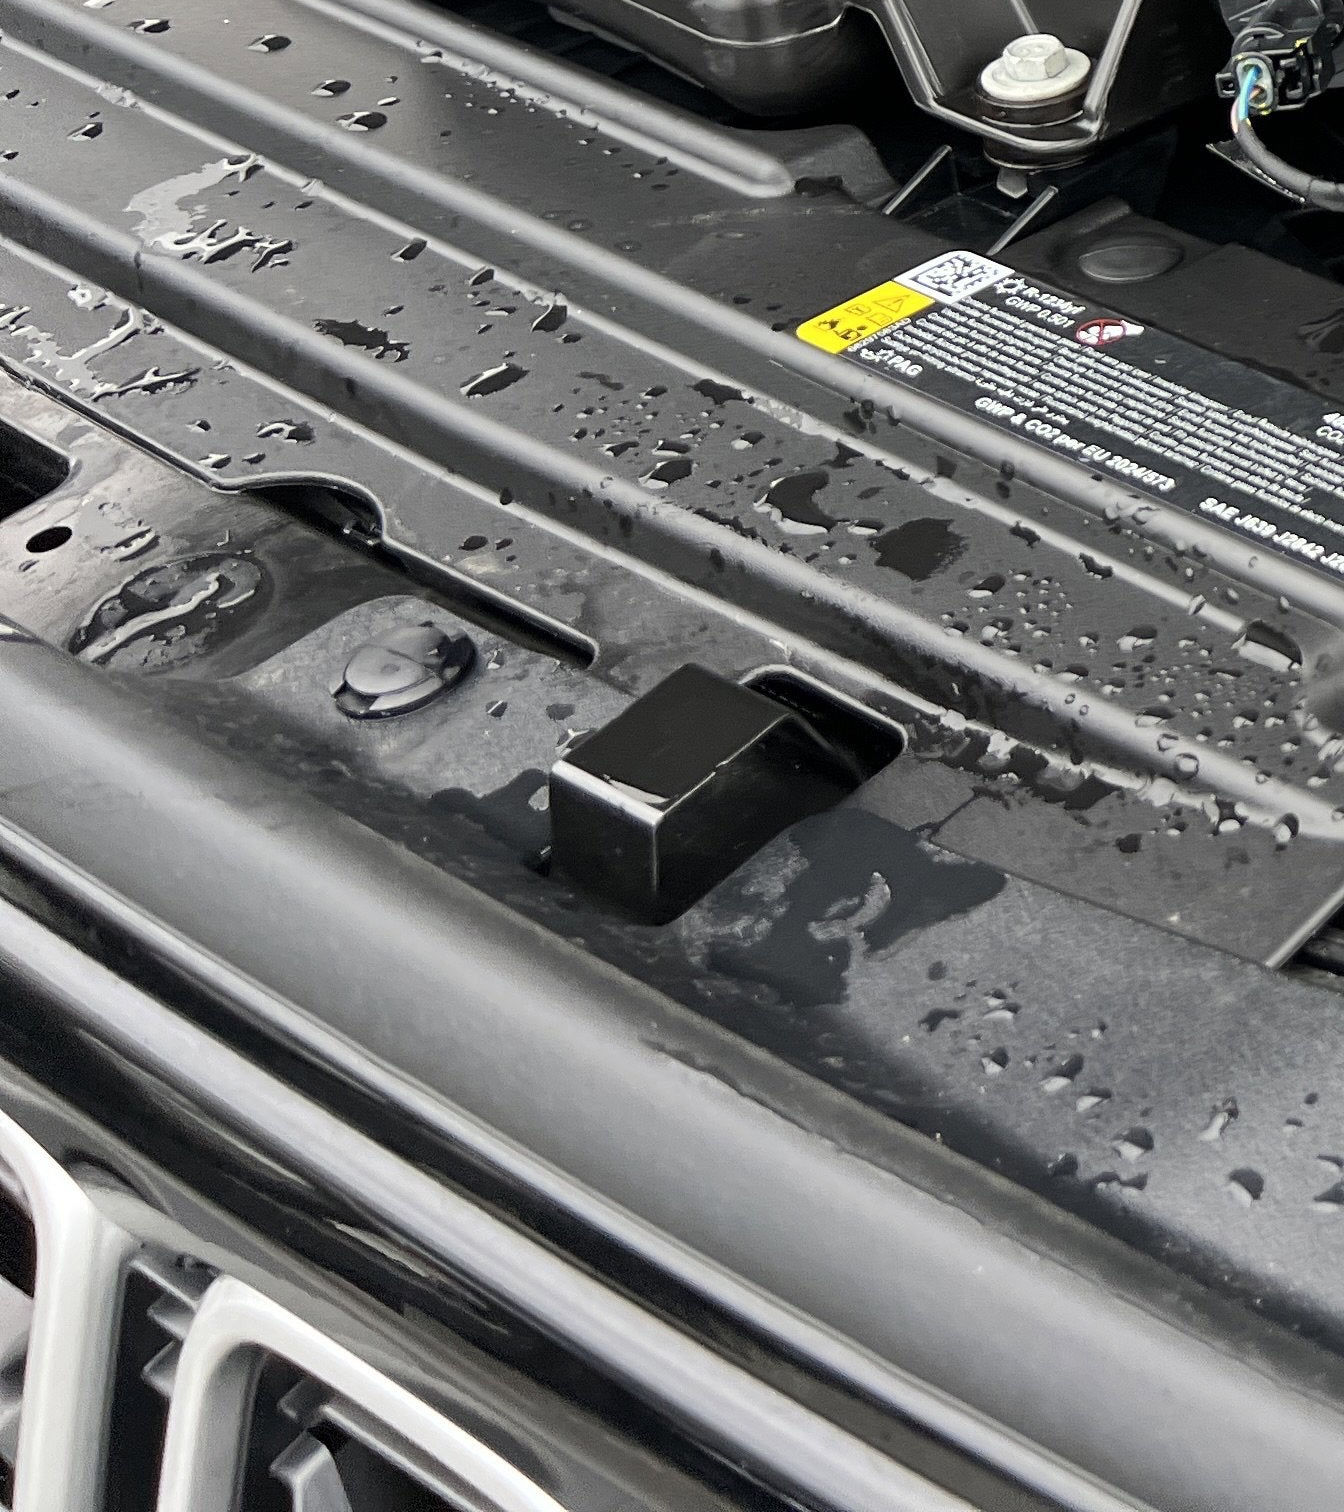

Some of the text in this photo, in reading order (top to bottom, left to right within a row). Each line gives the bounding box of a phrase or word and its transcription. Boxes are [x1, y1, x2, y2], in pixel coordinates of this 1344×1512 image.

[1005, 295, 1076, 328] GWP 0.501
[1024, 287, 1086, 314] R-1234yf
[888, 355, 923, 378] PAG
[975, 396, 1016, 417] GWP
[1010, 412, 1027, 427] &
[1025, 419, 1062, 441] CO2
[1053, 433, 1086, 451] per
[1081, 444, 1112, 461] EU
[1199, 497, 1240, 522] SAE
[1234, 514, 1277, 538] J639
